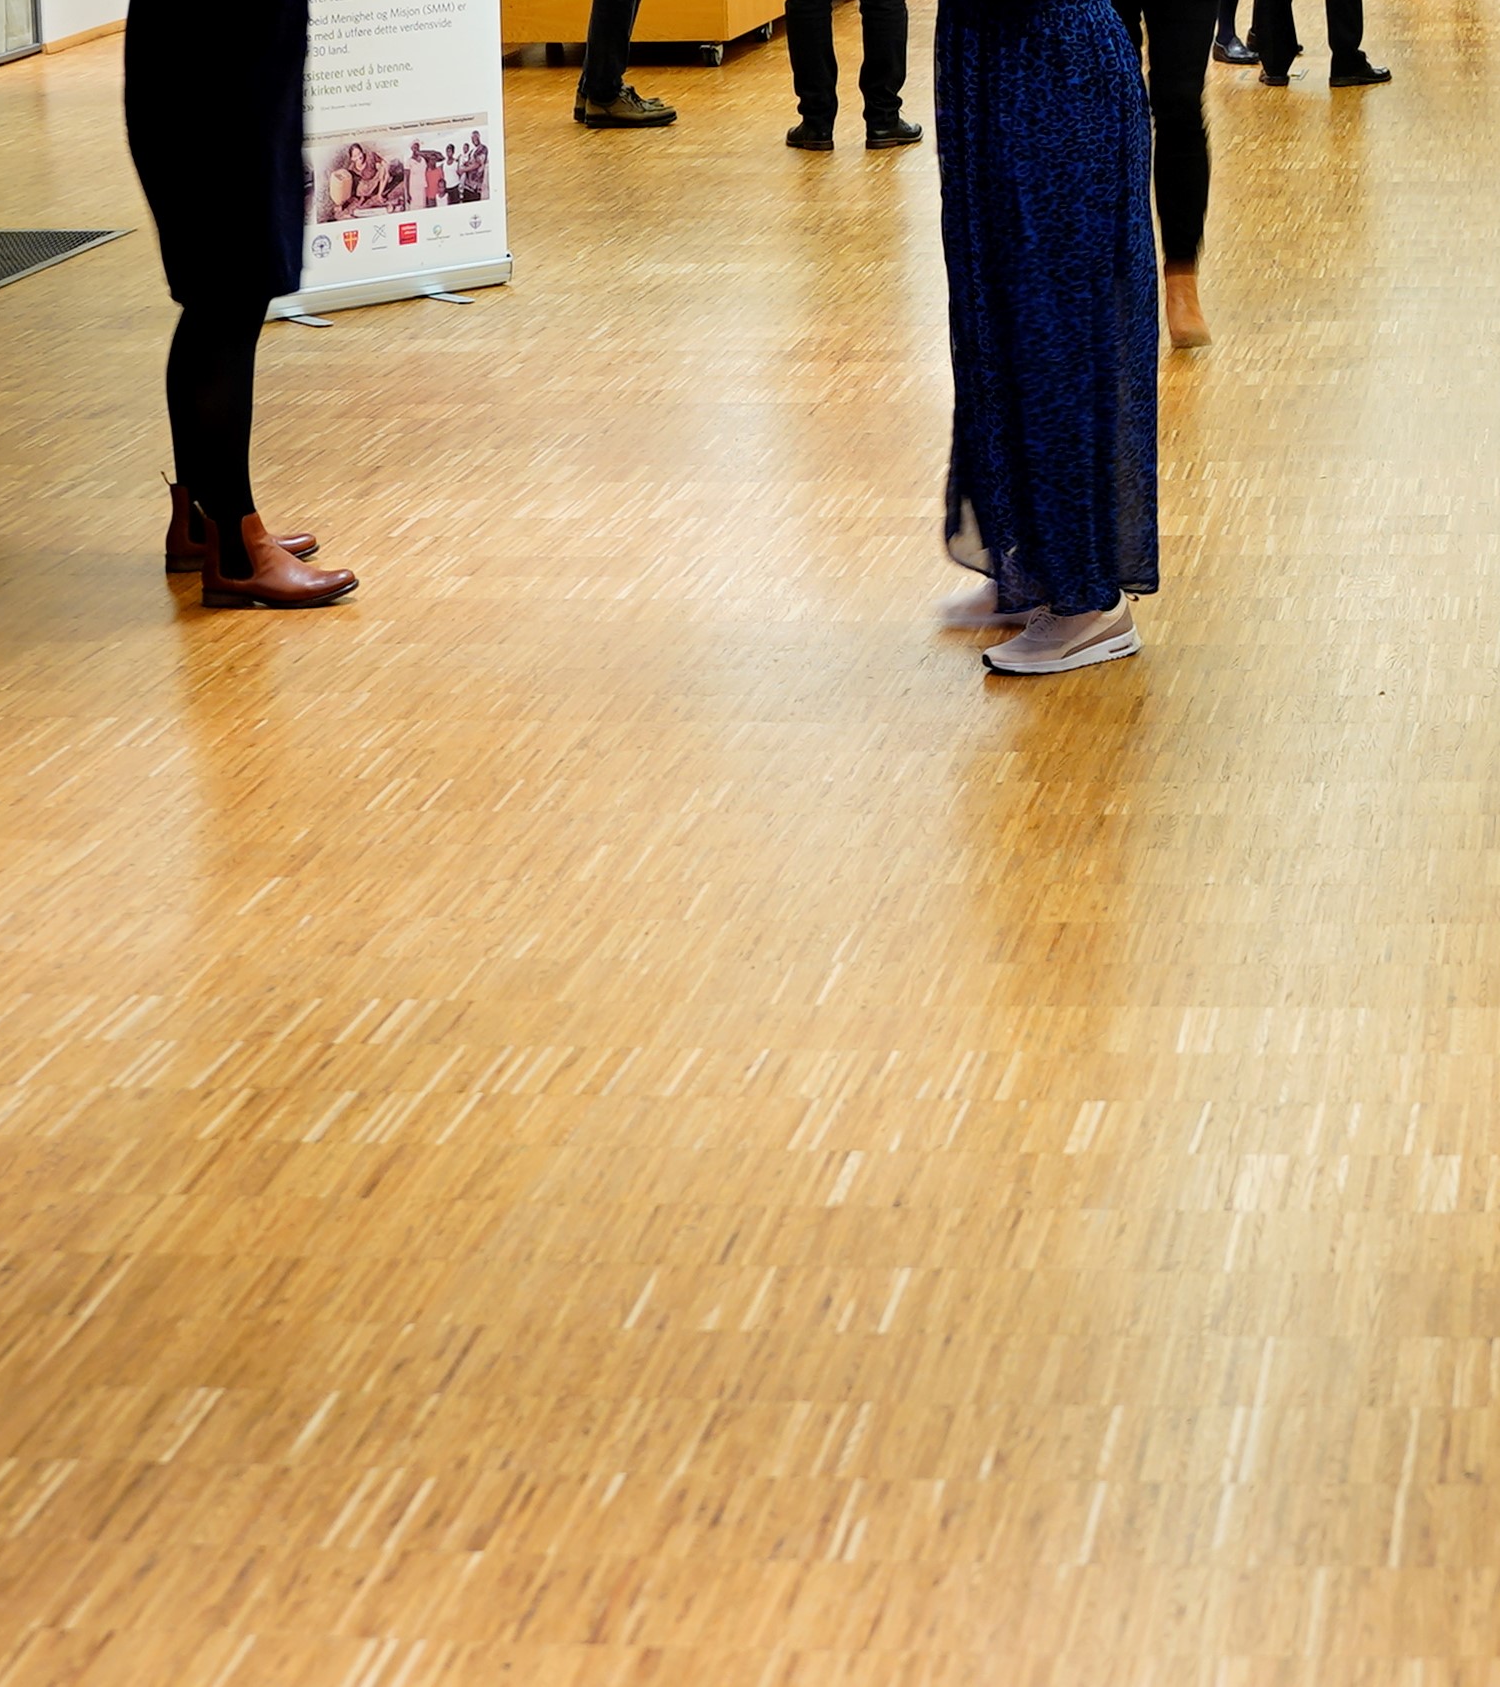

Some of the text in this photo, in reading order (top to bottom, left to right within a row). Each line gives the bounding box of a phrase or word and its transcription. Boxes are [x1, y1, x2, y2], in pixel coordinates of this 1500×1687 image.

[308, 1, 467, 27] beid Menighet og Misjon (SMM) er
[314, 30, 334, 41] med
[345, 27, 373, 38] utføre
[374, 25, 398, 35] dette
[400, 18, 452, 32] verdensvide
[313, 45, 326, 57] 30
[347, 66, 365, 78] ved
[368, 63, 374, 75] å
[310, 84, 342, 97] kirken
[344, 81, 363, 93] ved
[366, 79, 372, 91] å
[374, 78, 400, 89] være
